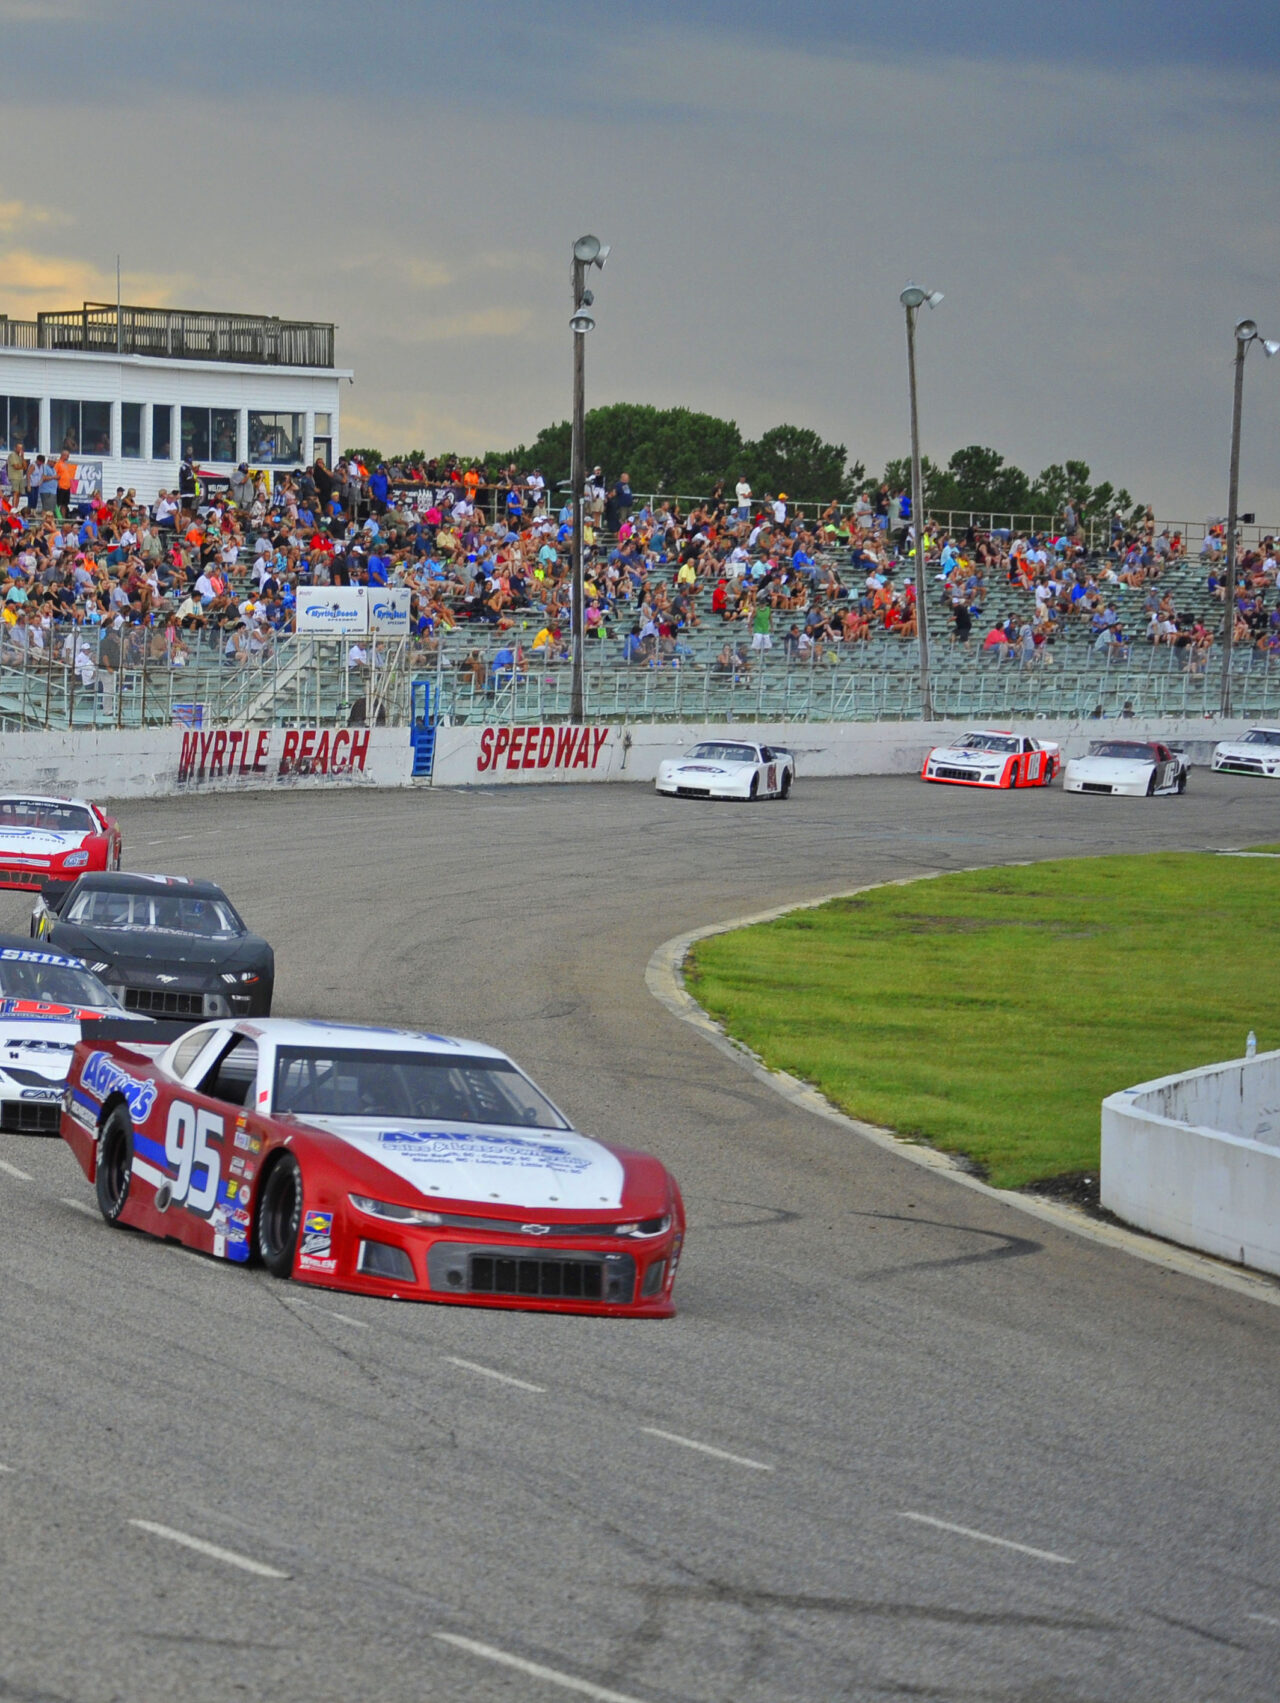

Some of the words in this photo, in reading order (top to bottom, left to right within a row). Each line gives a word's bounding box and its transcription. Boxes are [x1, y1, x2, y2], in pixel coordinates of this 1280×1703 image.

[178, 730, 269, 782] MYRTLE
[278, 730, 370, 775] BEACH
[477, 727, 609, 772] SPEEDWAY
[165, 1100, 224, 1214] 95
